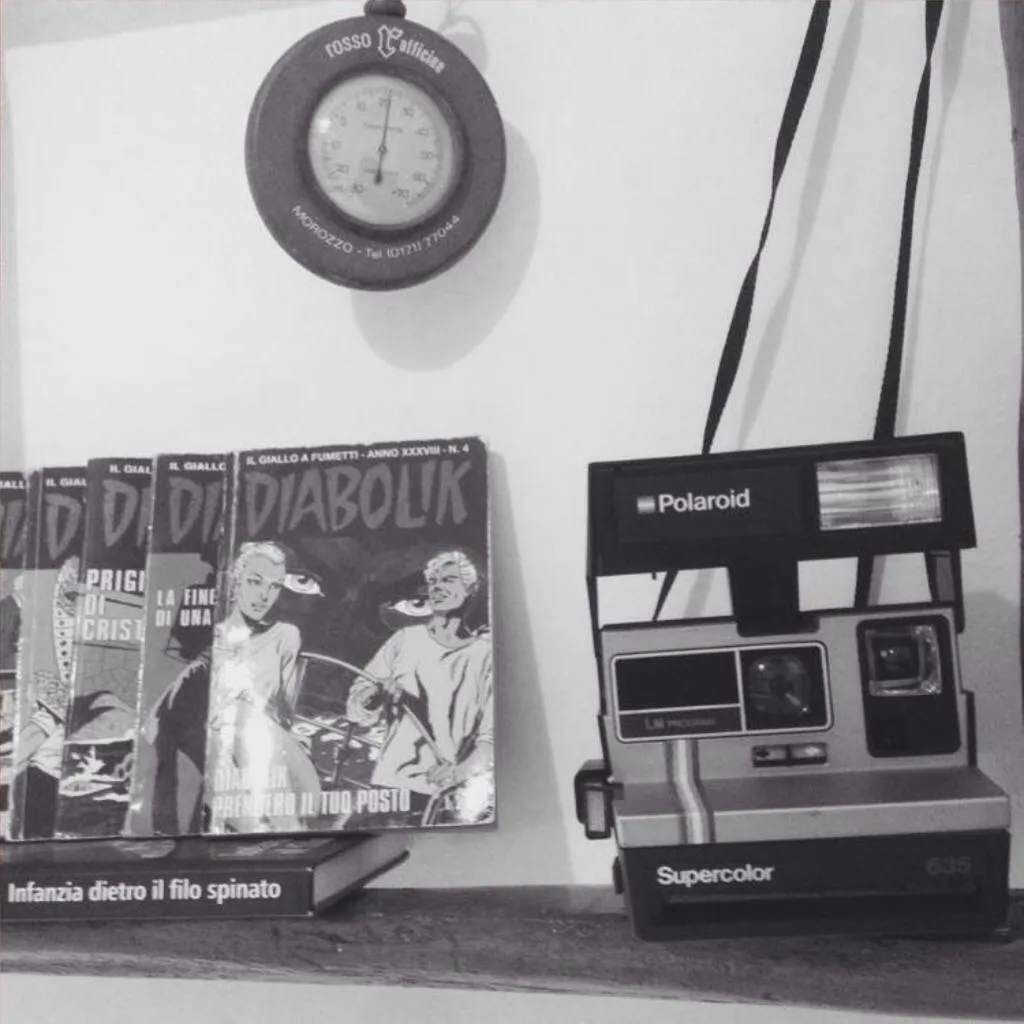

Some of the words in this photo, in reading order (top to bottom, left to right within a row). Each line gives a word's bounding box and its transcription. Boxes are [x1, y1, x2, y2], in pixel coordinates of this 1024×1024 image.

[291, 206, 353, 255] MOROZZO
[424, 215, 460, 248] 77044
[246, 456, 255, 466] IL
[258, 453, 298, 465] GIALLO
[301, 452, 308, 462] A
[311, 451, 358, 462] FUMETTI
[367, 448, 399, 459] ANNO
[462, 444, 468, 453] 4
[243, 460, 472, 537] DIABOLIK
[658, 488, 749, 513] Polaroid
[84, 594, 105, 615] DI
[156, 589, 174, 606] LA
[184, 588, 216, 606] FINE
[155, 610, 171, 627] DI
[180, 609, 211, 627] UNA
[320, 790, 351, 816] TUO
[356, 789, 409, 815] POSTO
[656, 864, 773, 889] Supercolor
[7, 881, 83, 903] Infanzia
[87, 880, 146, 901] dietro
[151, 879, 164, 900] il
[169, 878, 201, 901] filo
[207, 878, 281, 905] spinato
